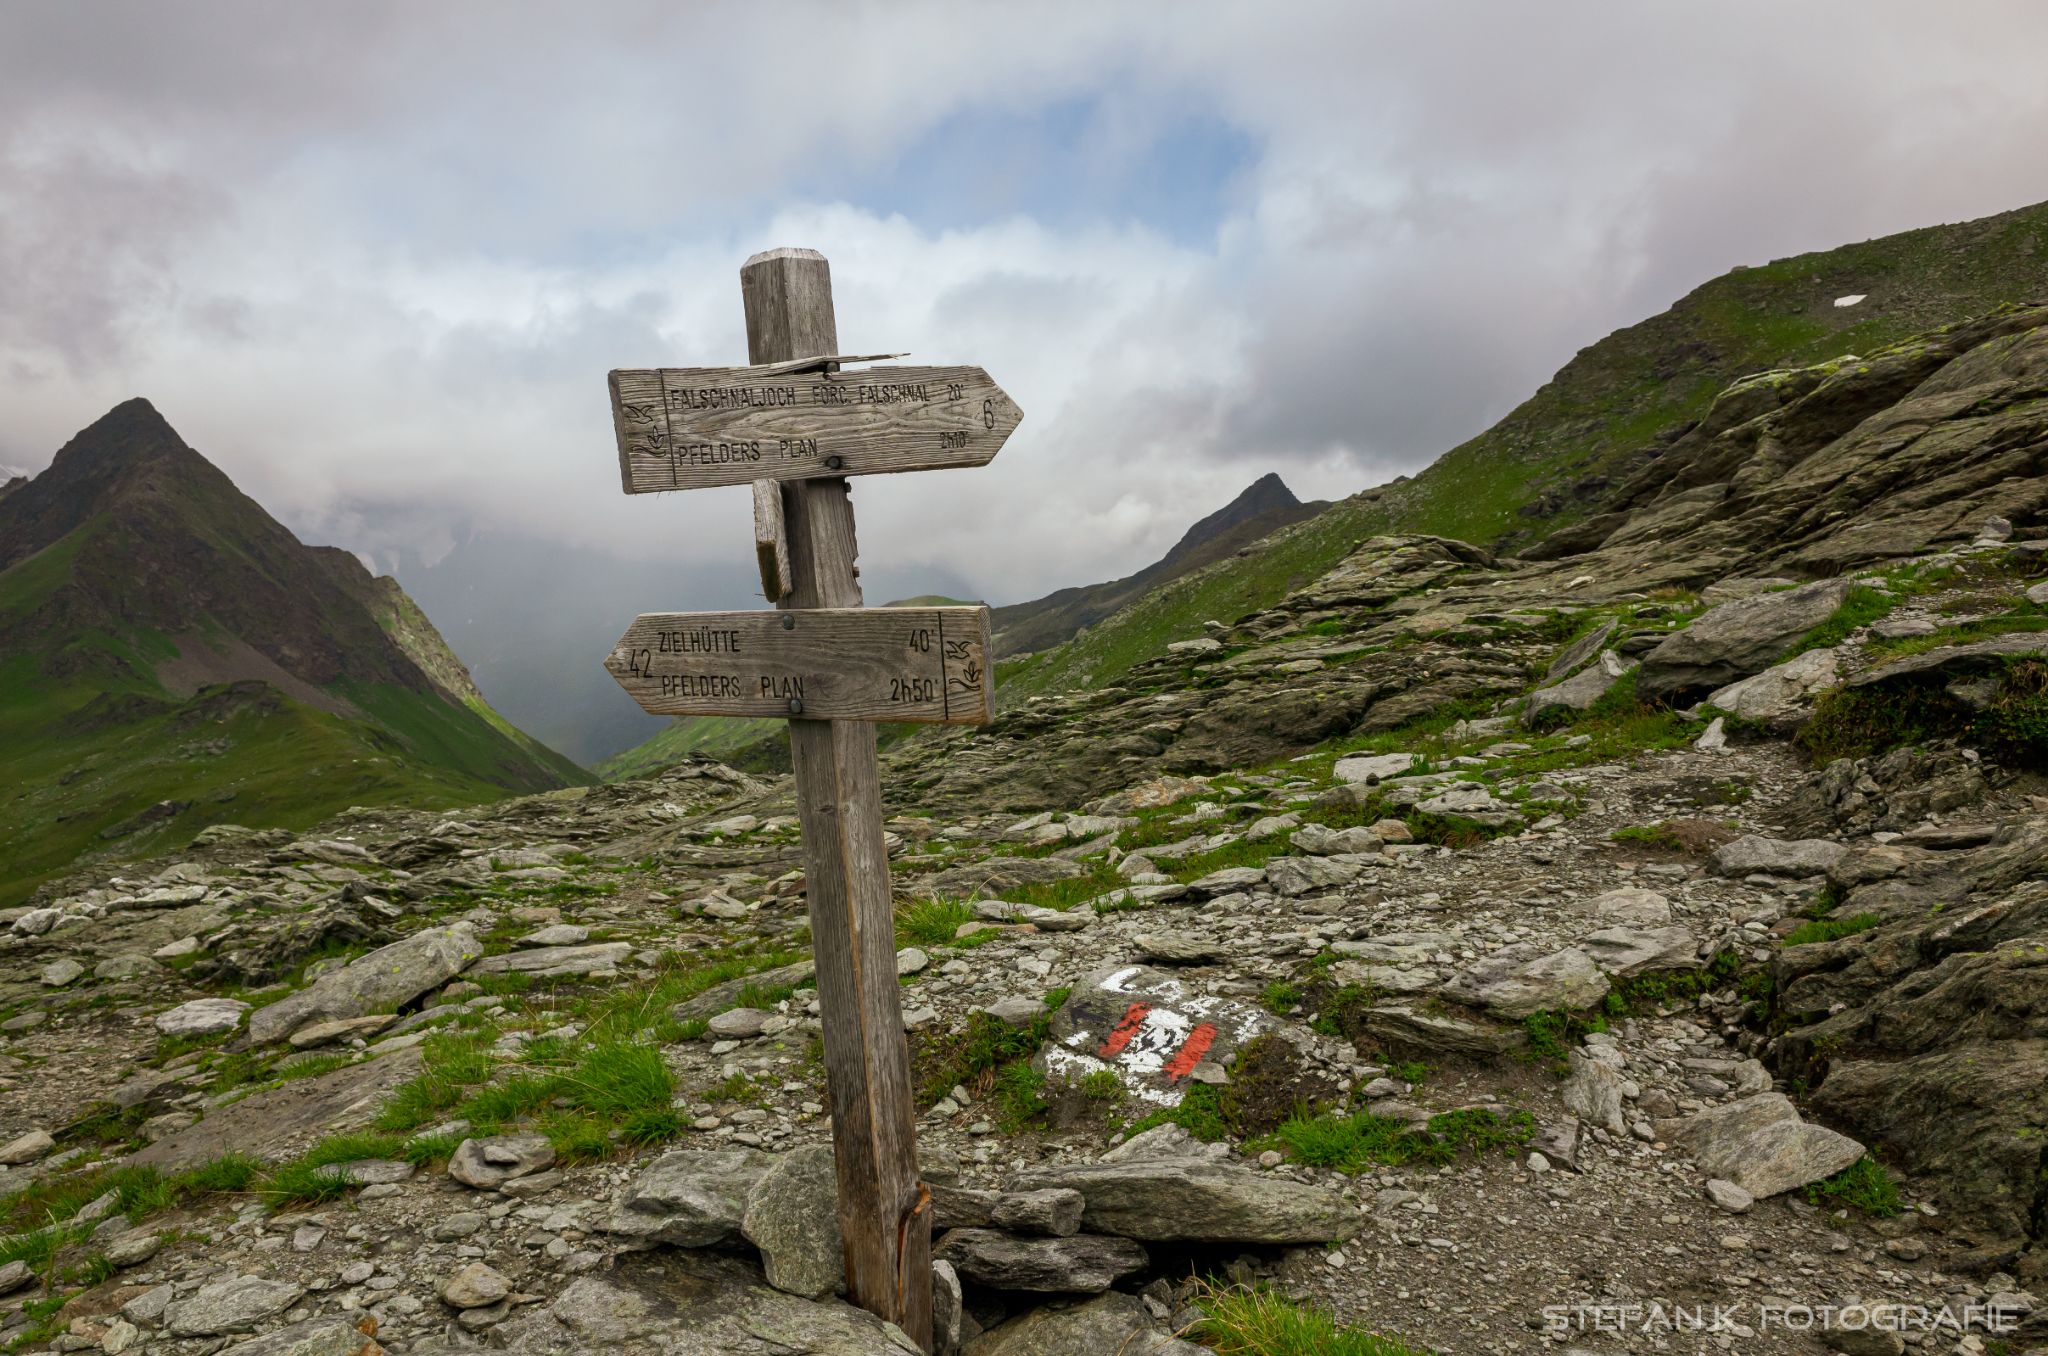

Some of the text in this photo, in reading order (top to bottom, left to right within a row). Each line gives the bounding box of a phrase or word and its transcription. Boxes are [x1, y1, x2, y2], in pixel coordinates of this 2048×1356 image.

[671, 387, 796, 410] FALSCHNALJOCH
[859, 384, 931, 404] FALSCHNAL
[982, 400, 995, 429] 6
[678, 442, 761, 466] PFELDERS
[780, 439, 818, 459] PLAN
[658, 626, 741, 653] ZIELHÜTTE
[629, 649, 652, 679] 42
[662, 675, 741, 697] PFELDERS
[760, 676, 804, 698] PLAN
